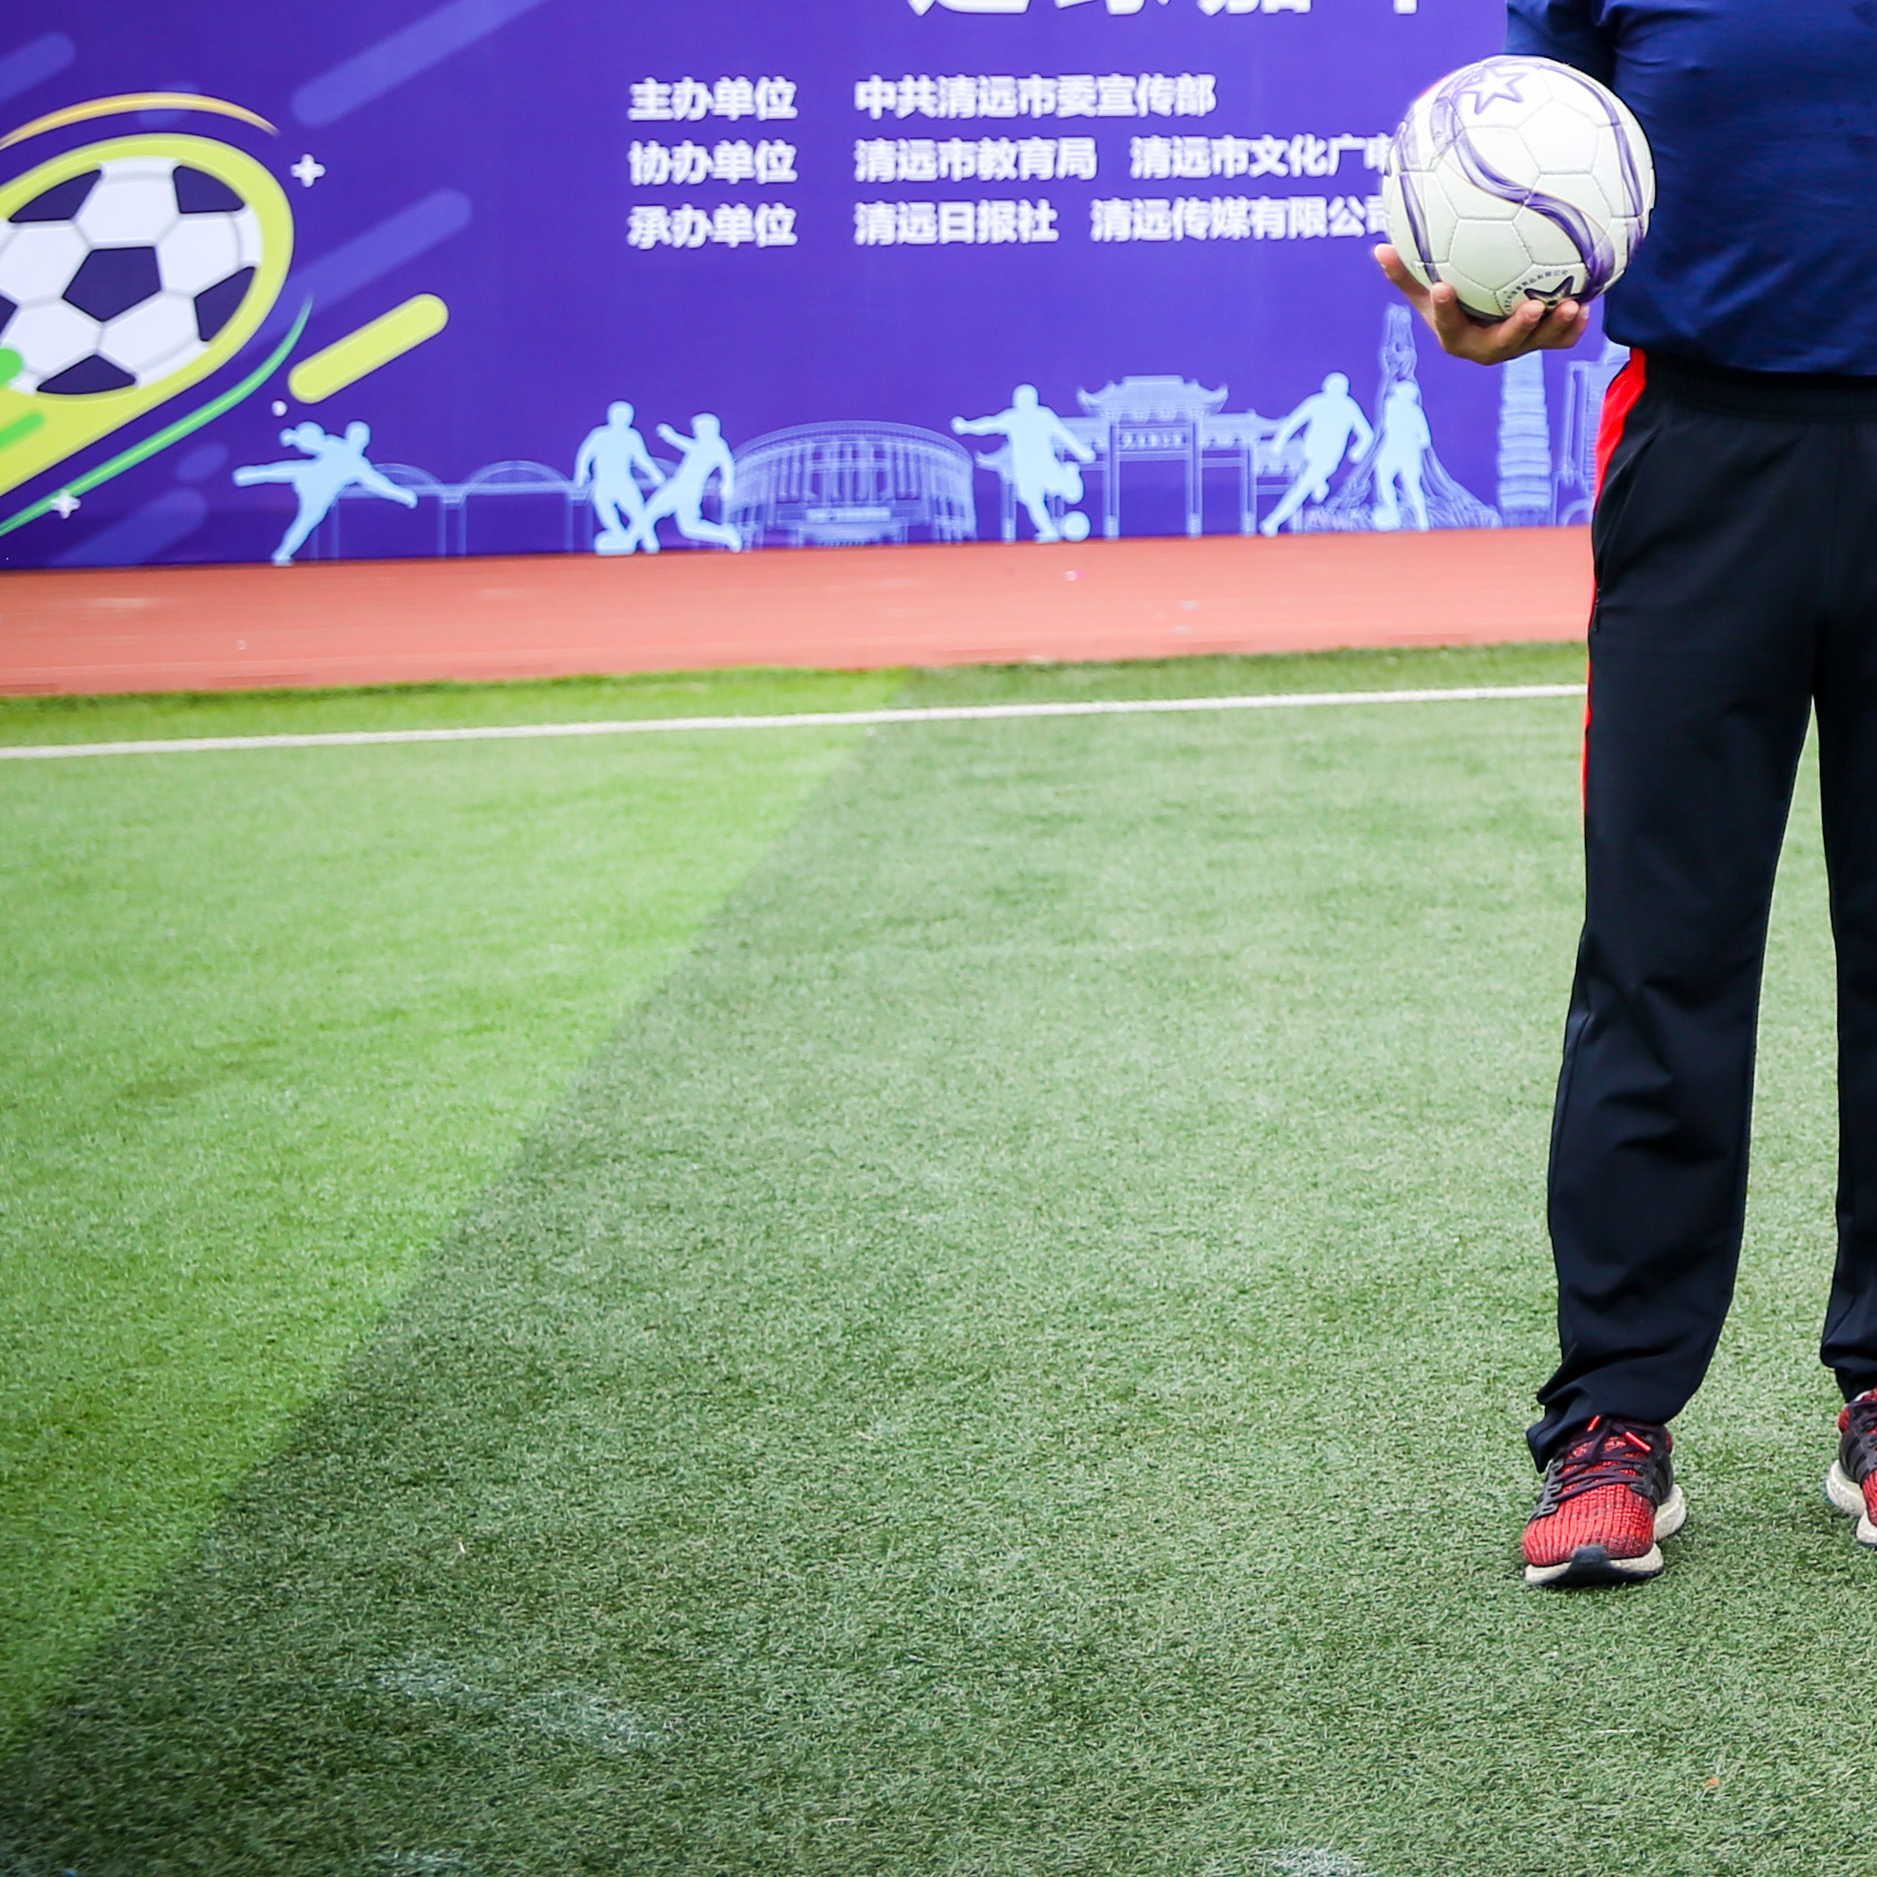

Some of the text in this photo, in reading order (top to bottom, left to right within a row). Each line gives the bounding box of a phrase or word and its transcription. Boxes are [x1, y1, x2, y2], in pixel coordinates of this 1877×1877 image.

[627, 73, 1217, 121] 主办单位 中共清远市委宣传部
[627, 140, 798, 185] 协办单位
[853, 137, 1098, 182] 清远市教育局
[627, 203, 798, 249] 承办单位
[853, 200, 1059, 245] 清远日报社
